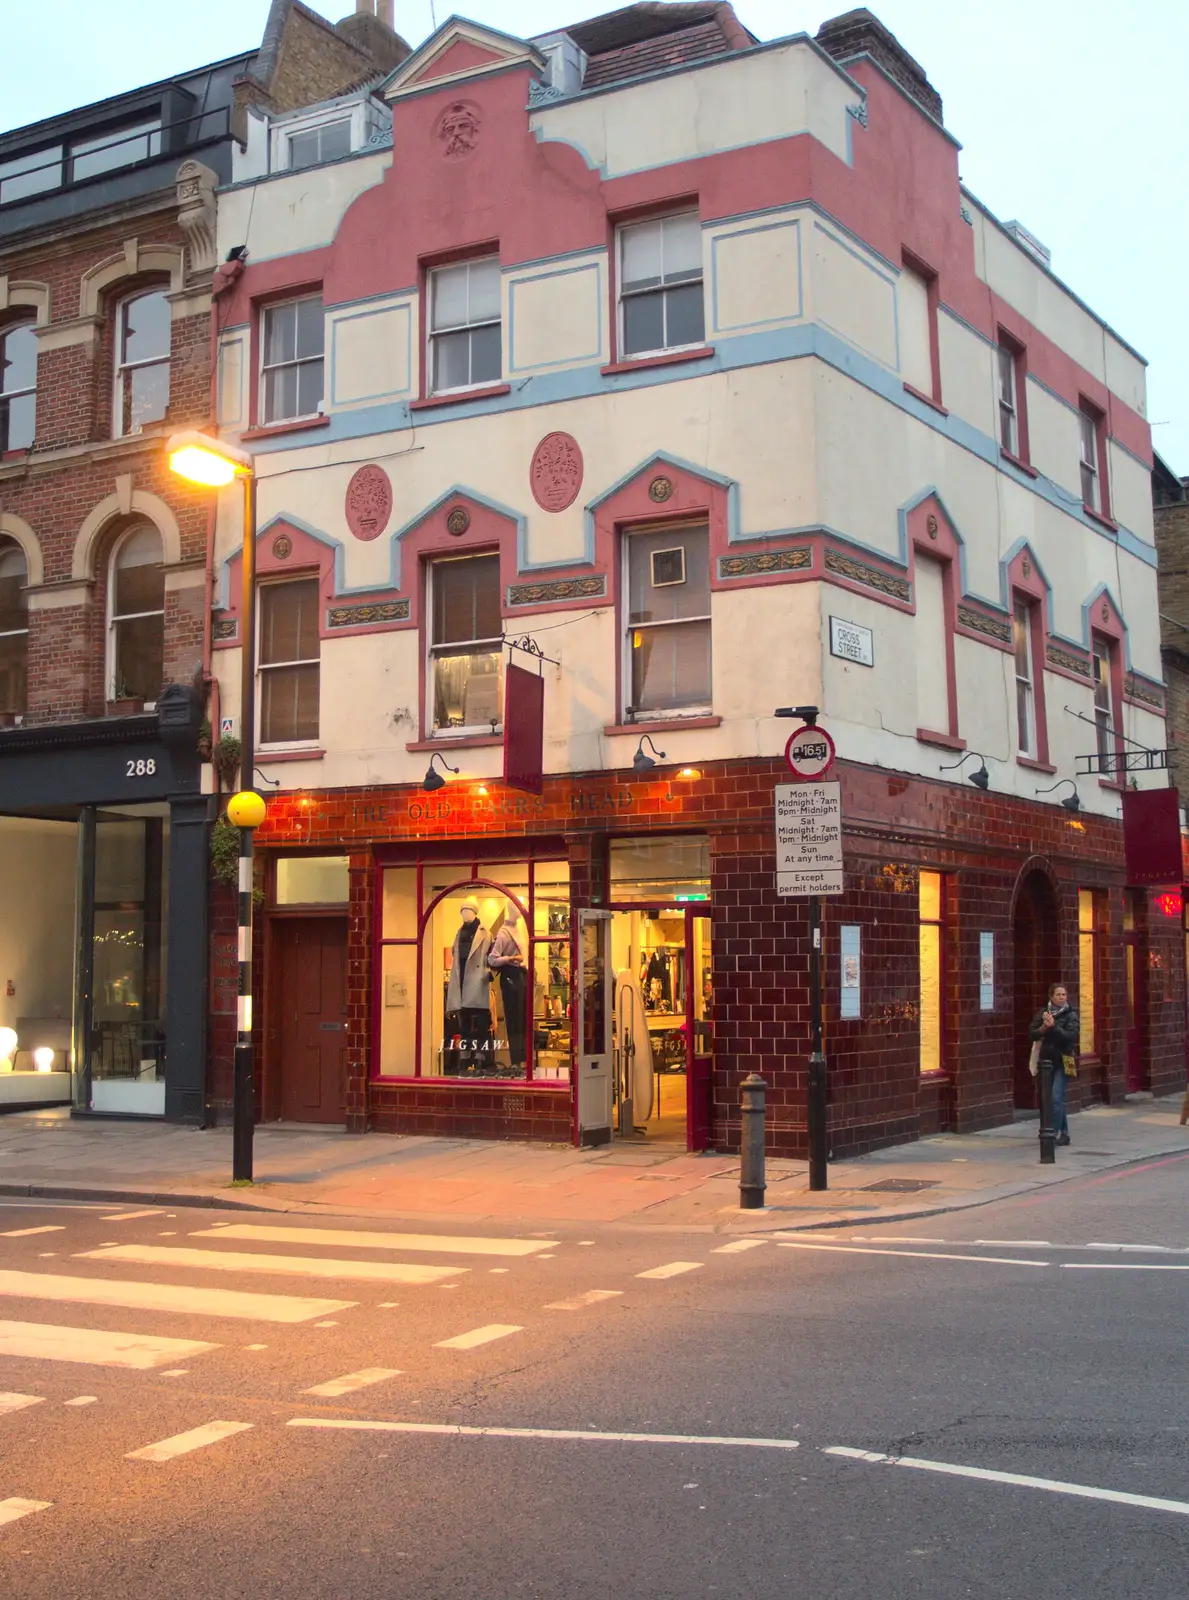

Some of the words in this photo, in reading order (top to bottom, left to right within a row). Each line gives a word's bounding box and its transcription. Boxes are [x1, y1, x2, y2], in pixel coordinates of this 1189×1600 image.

[838, 628, 860, 646] CROSS
[838, 641, 862, 658] STREET
[126, 759, 156, 776] 288
[814, 789, 825, 797] Fri
[351, 805, 388, 823] THE
[409, 801, 451, 819] OLD
[571, 791, 633, 811] HEAD
[778, 799, 814, 808] Midnight
[820, 797, 838, 805] 7am
[778, 808, 796, 816] 9pm
[800, 806, 838, 814] Midnight
[778, 826, 814, 835] Midnight
[779, 836, 795, 844] 1pm
[801, 834, 838, 843] Midnight
[785, 855, 794, 863] At
[797, 855, 812, 863] any
[795, 874, 824, 882] Except
[779, 885, 806, 893] permit
[438, 1039, 505, 1053] JIGSAW
